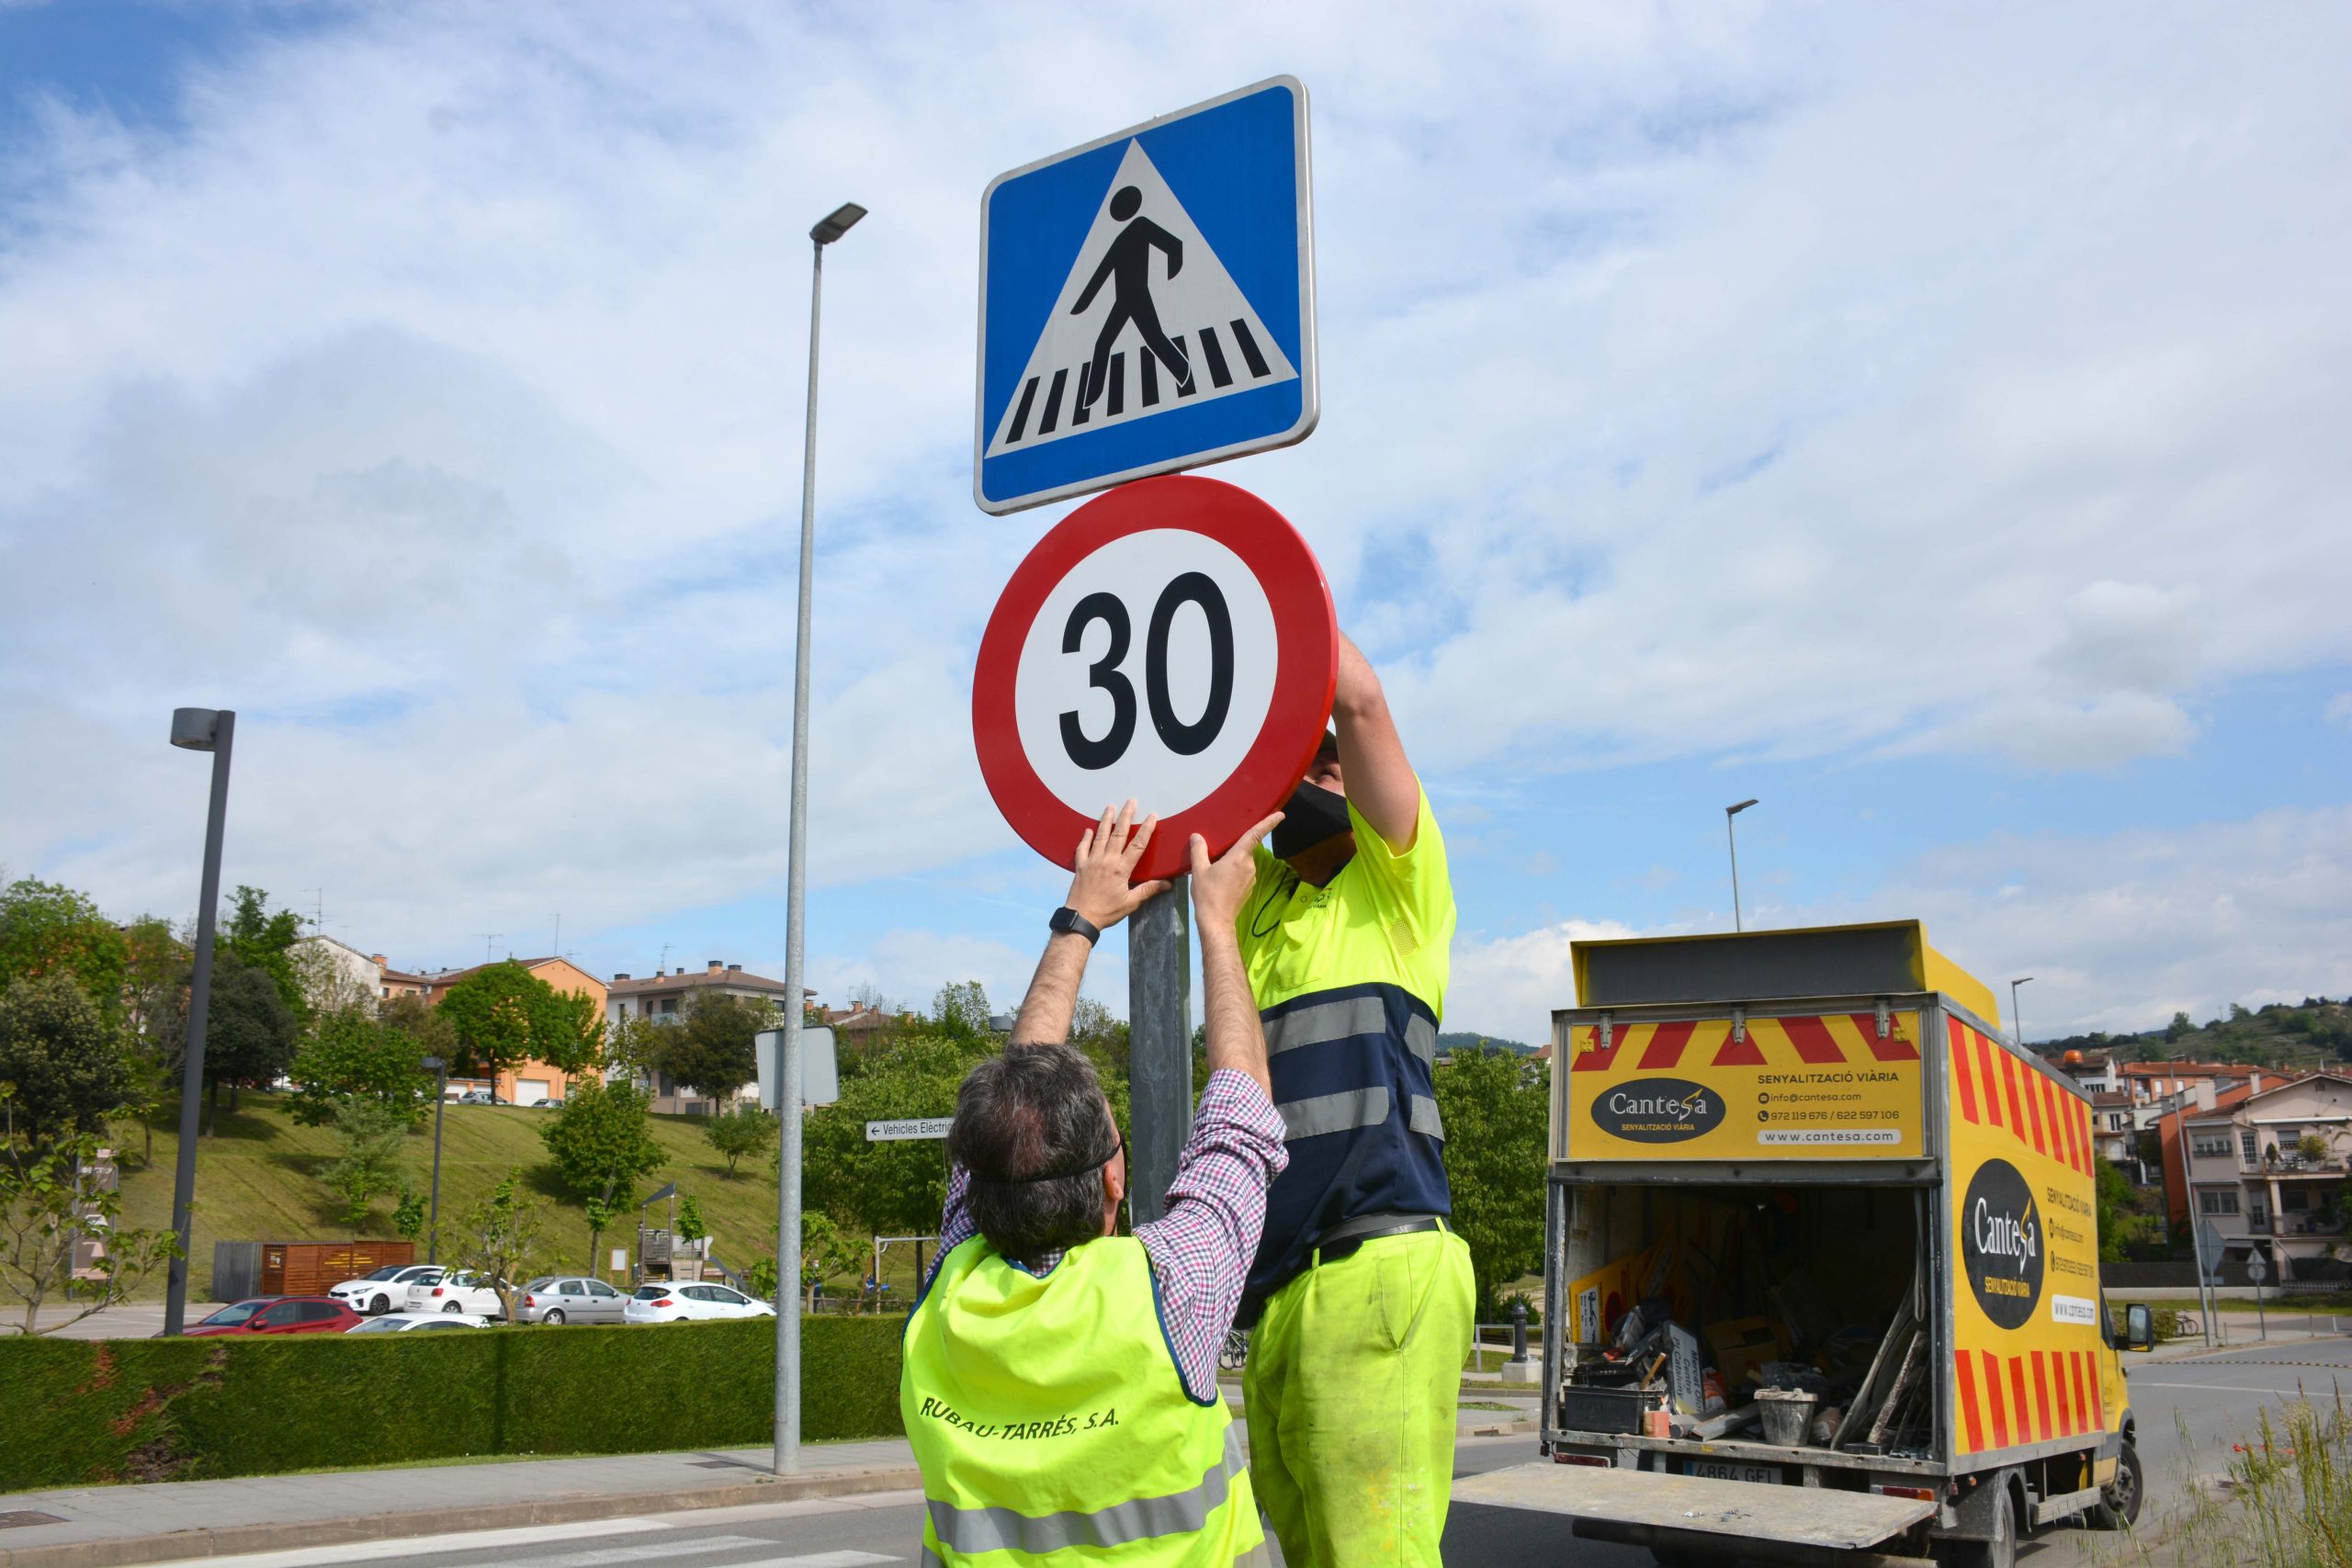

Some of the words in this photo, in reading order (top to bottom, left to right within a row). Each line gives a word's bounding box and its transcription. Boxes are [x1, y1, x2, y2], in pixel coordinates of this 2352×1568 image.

[1059, 571, 1234, 770] 30
[1758, 1070, 1853, 1084] SENYALITZACIÓ
[1857, 1069, 1899, 1082] VIÀRIA
[1610, 1089, 1707, 1122] Cantesa
[1770, 1092, 1861, 1103] info@cantesa.com
[1770, 1111, 1790, 1120] 972
[1792, 1111, 1806, 1120] 119
[1808, 1111, 1827, 1120] 676
[1837, 1111, 1857, 1120] 622
[1860, 1110, 1878, 1120] 597
[1881, 1110, 1900, 1119] 106
[883, 1123, 918, 1135] Vehicles
[920, 1121, 953, 1134] Elèctric
[1621, 1122, 1671, 1131] SENYALITZACIÓ
[1673, 1122, 1695, 1131] VIÀRIA
[1765, 1132, 1894, 1142] www.cantesa.com
[1974, 1197, 2036, 1275] Cantesa
[1683, 1358, 1691, 1394] Centre
[1690, 1350, 1700, 1387] Mercat
[920, 1396, 1078, 1440] RUBAU-TARRÉS,
[1083, 1408, 1119, 1429] S.A.
[1696, 1463, 1738, 1481] 4864
